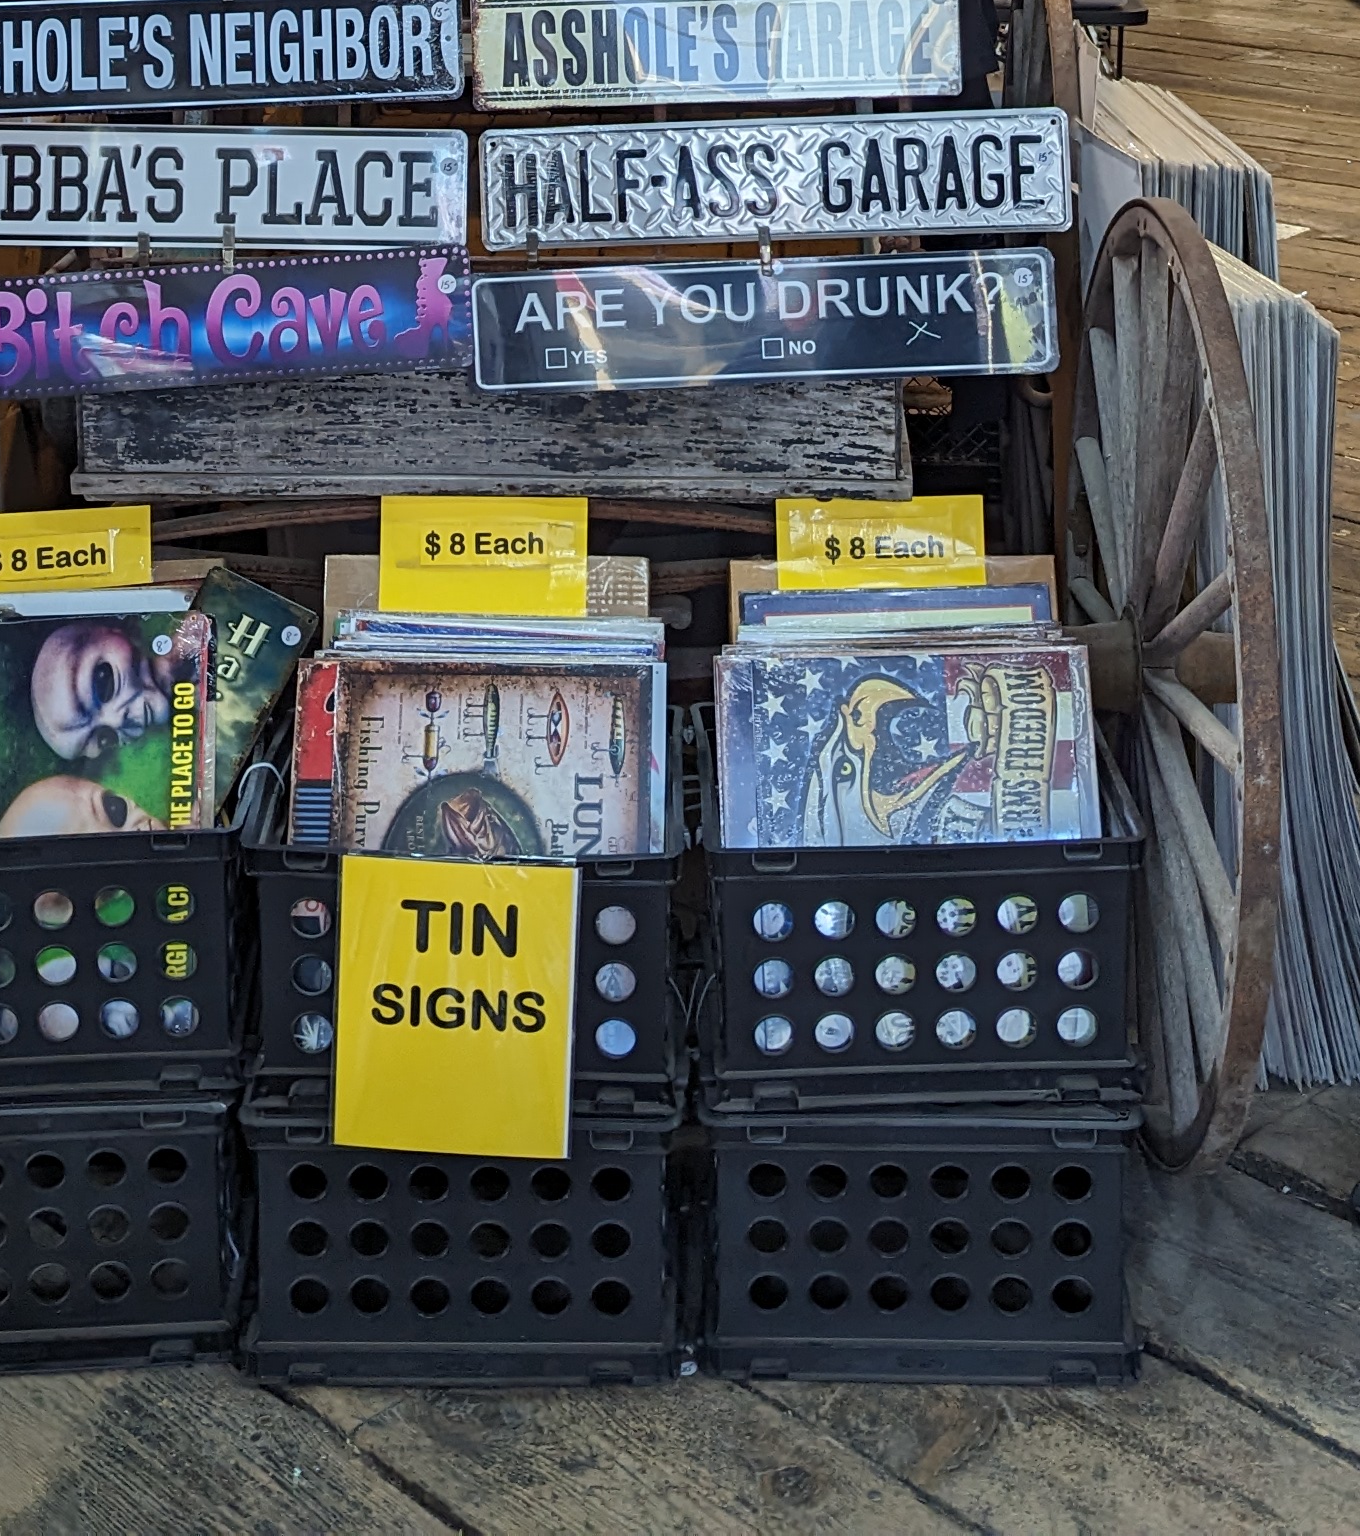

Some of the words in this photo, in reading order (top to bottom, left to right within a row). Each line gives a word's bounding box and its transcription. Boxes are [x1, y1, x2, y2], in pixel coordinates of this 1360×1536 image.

[190, 4, 435, 89] NEIGHBOR
[502, 2, 739, 88] ASSHOLE'S
[215, 148, 440, 227] PLACE
[502, 142, 779, 228] HALF-ASS
[821, 134, 1046, 214] GARAGE
[207, 273, 386, 367] Cave
[514, 287, 626, 334] ARE
[638, 280, 755, 328] YOU
[778, 273, 1004, 323] DRUNK?
[569, 350, 608, 366] YES
[789, 340, 817, 356] NO
[11, 549, 28, 572] 8
[36, 543, 107, 570] Each
[424, 531, 441, 559] $
[449, 534, 466, 556] 8
[474, 532, 544, 556] Each
[824, 534, 841, 565] $
[849, 538, 866, 560] 8
[874, 534, 945, 560] Each
[172, 682, 195, 709] GO
[1005, 672, 1048, 772] FREEDOM
[172, 711, 194, 738] TO
[171, 740, 193, 793] PLACE
[358, 715, 385, 794] Fishing
[401, 898, 520, 958] TIN
[371, 983, 546, 1033] SIGNS
